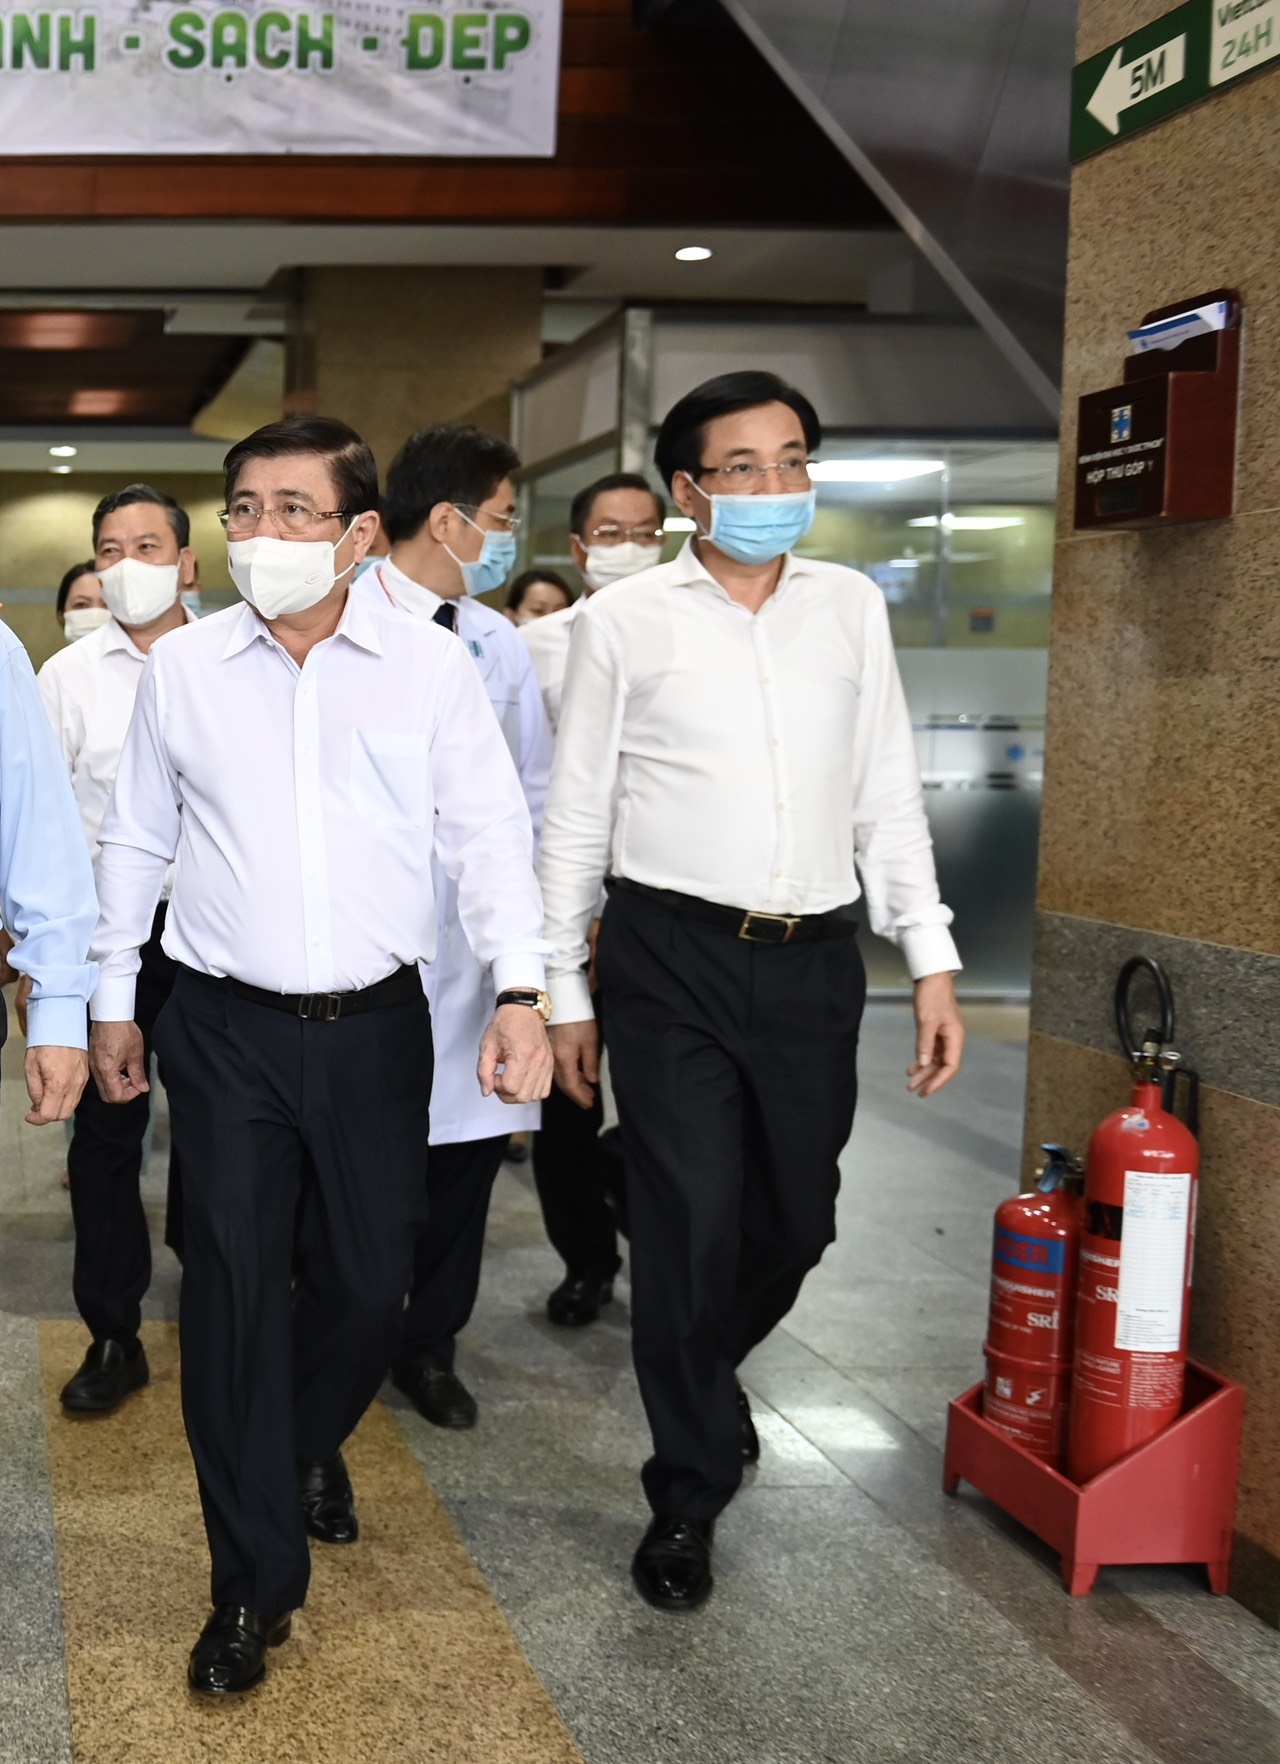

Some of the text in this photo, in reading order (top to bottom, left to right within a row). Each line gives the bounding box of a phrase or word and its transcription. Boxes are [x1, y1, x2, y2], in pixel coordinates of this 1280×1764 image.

[167, 11, 334, 82] SẠCH
[400, 13, 531, 84] ĐẸP
[1221, 16, 1274, 70] 24H
[1129, 48, 1166, 100] 5M
[1095, 1284, 1120, 1303] SR
